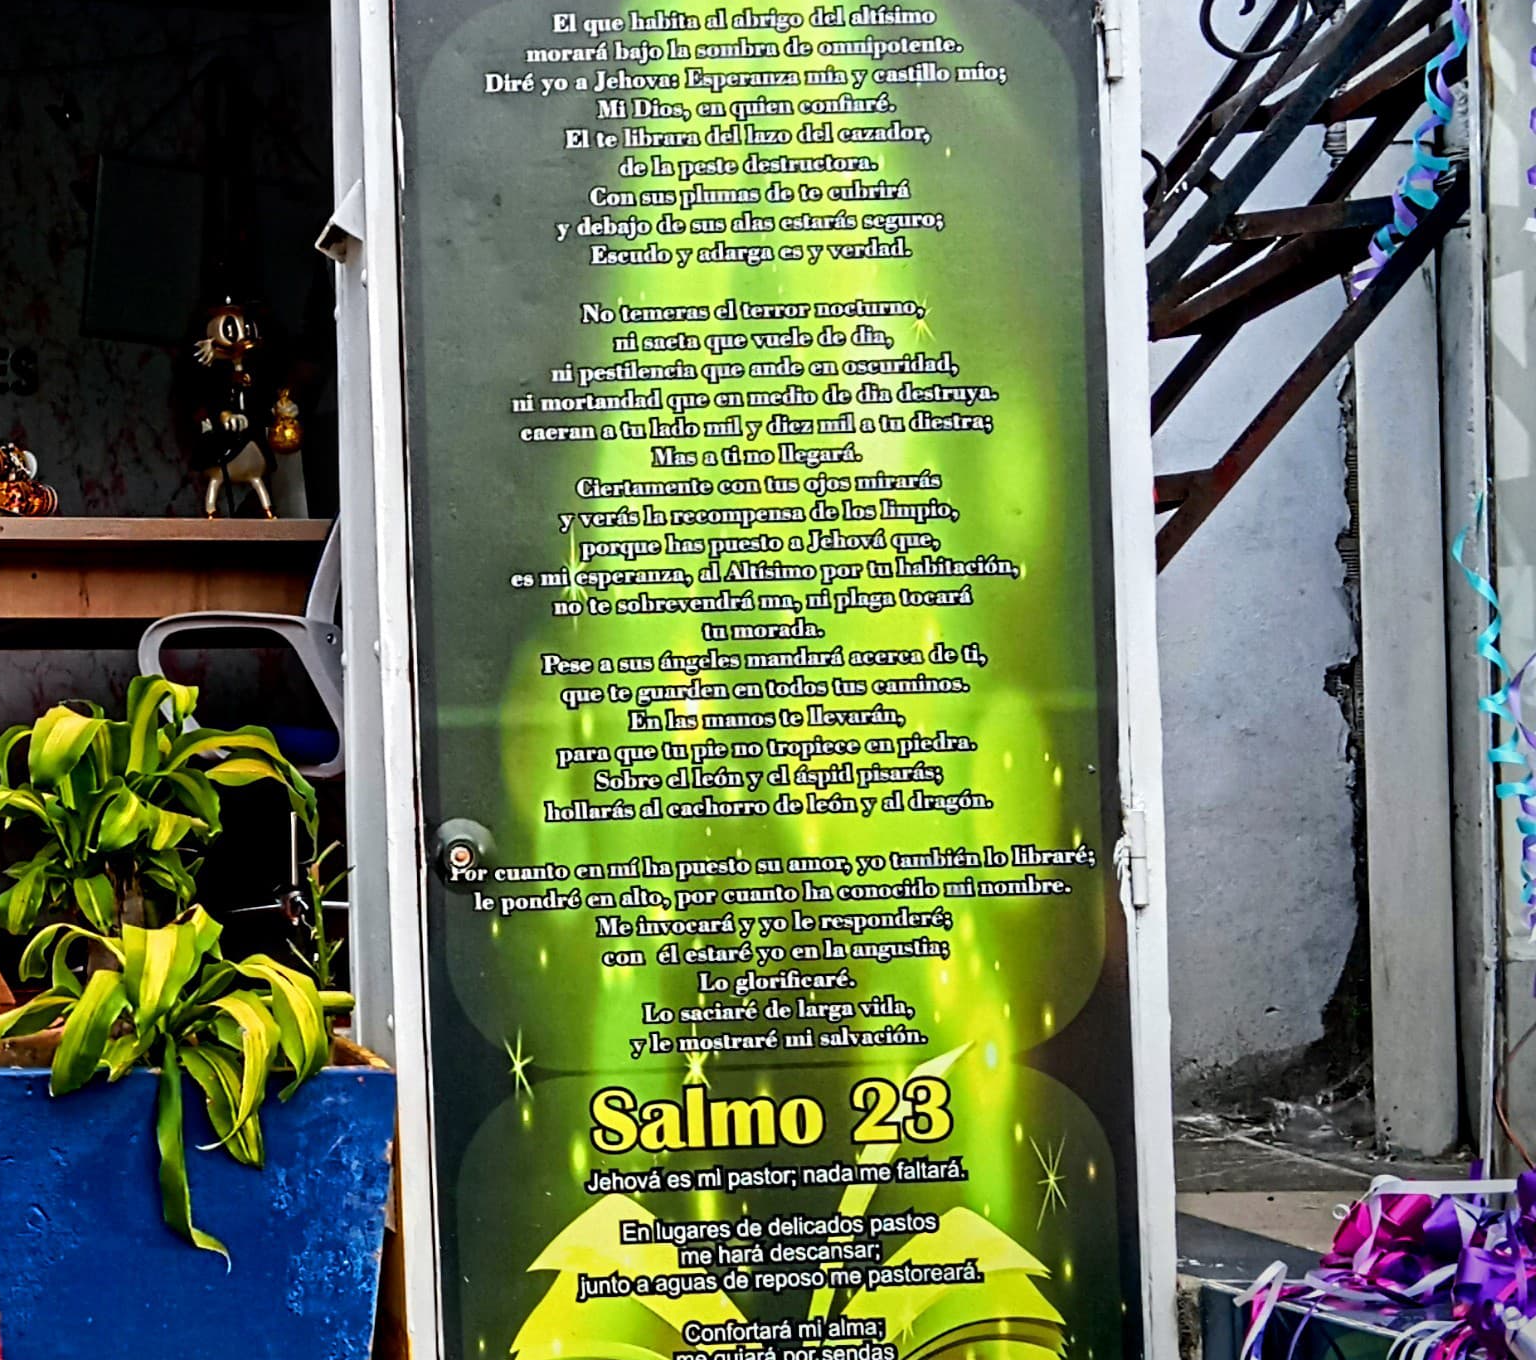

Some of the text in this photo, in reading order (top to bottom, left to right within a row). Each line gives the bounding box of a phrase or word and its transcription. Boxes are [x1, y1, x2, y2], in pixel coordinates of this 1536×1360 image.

[553, 7, 936, 39] El que habita al abrigo del altísimo
[527, 37, 963, 64] morará bajo la sombra de omnipotente.
[597, 95, 895, 121] Mi Dios, en quien confiaré.
[565, 123, 930, 149] El te librara del lazo del cazador,
[582, 301, 925, 323] No temeras el terror nocturno,
[614, 336, 636, 350] ni
[643, 335, 698, 350] saeta
[705, 337, 746, 354] que
[753, 331, 811, 348] vuele
[819, 330, 844, 345] de
[577, 476, 941, 497] Ciertamente con tus ojos mirarás
[582, 531, 939, 559] porque has puesto a Jehová que,
[562, 677, 969, 708] que te guarden en todos tus caminos.
[631, 705, 904, 730] En las manos te llevarán,
[596, 764, 943, 791] Sobre el león y el áspid pisarás;
[700, 971, 855, 996] Lo glorificaré.
[645, 996, 914, 1023] Lo saciaré de larga vida,
[590, 1076, 953, 1151] Salmo 23
[622, 1213, 937, 1247] En lugares de delicados pastos
[682, 1243, 880, 1264] me hará descansar;
[686, 1318, 883, 1342] Confortará mi alma;
